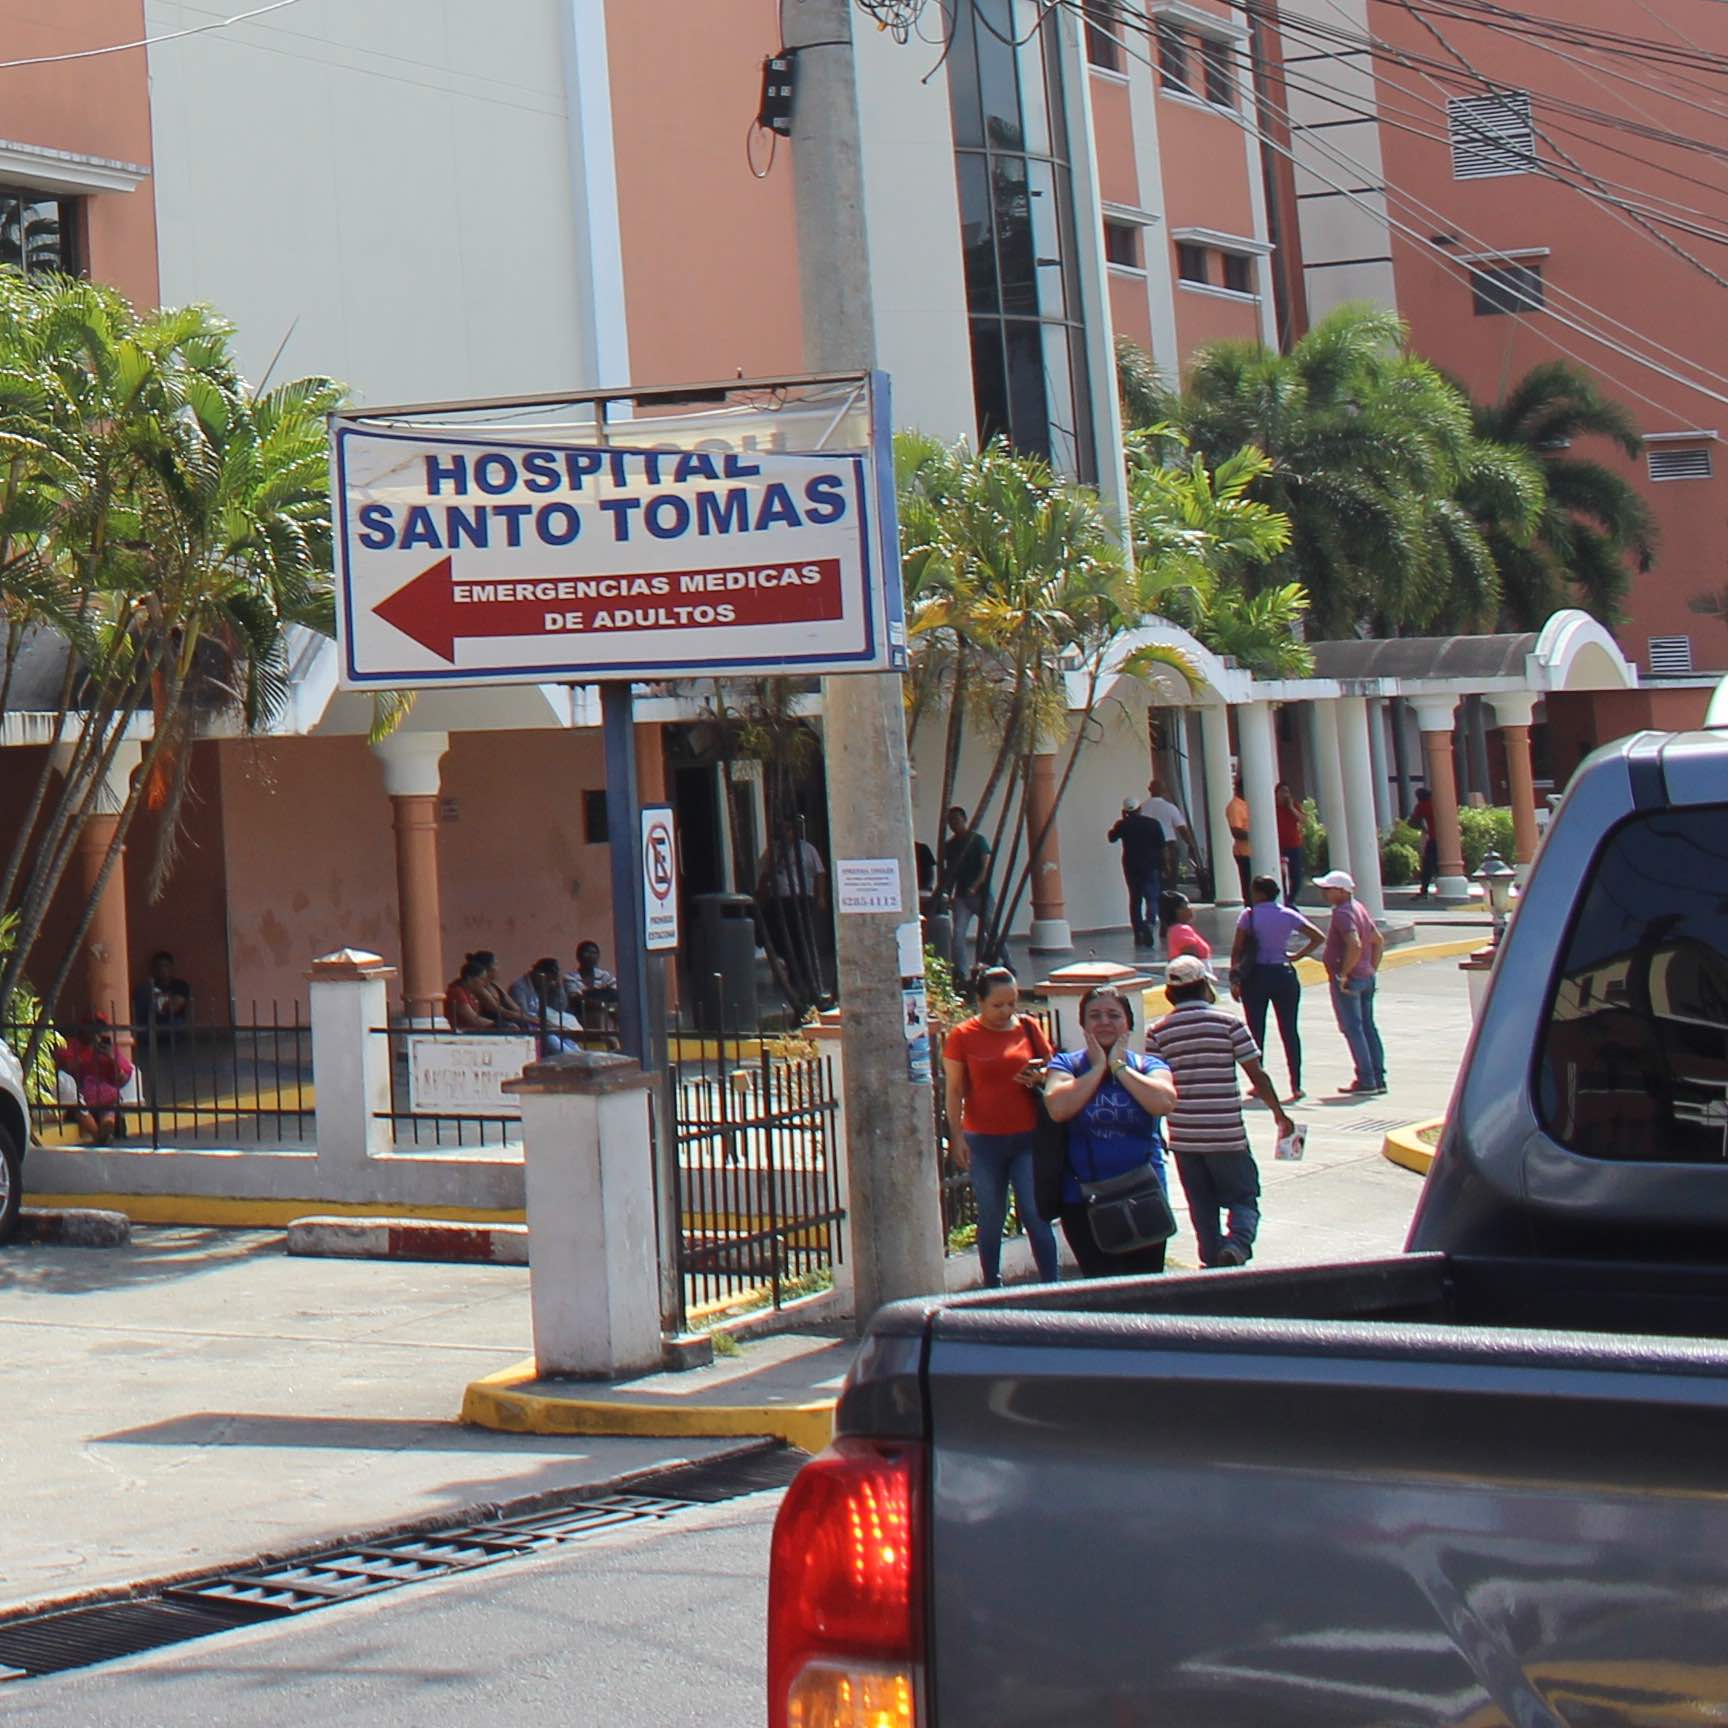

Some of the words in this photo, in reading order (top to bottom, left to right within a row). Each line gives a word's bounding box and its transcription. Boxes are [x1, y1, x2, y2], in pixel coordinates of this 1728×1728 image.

[425, 452, 761, 497] HOSPITAL
[358, 501, 581, 551] SANTO
[599, 474, 846, 543] TOMAS
[453, 576, 670, 603] EMERGENCIAS
[679, 565, 822, 594] MEDICAS
[544, 610, 583, 631] DE
[592, 604, 737, 628] ADULTOS
